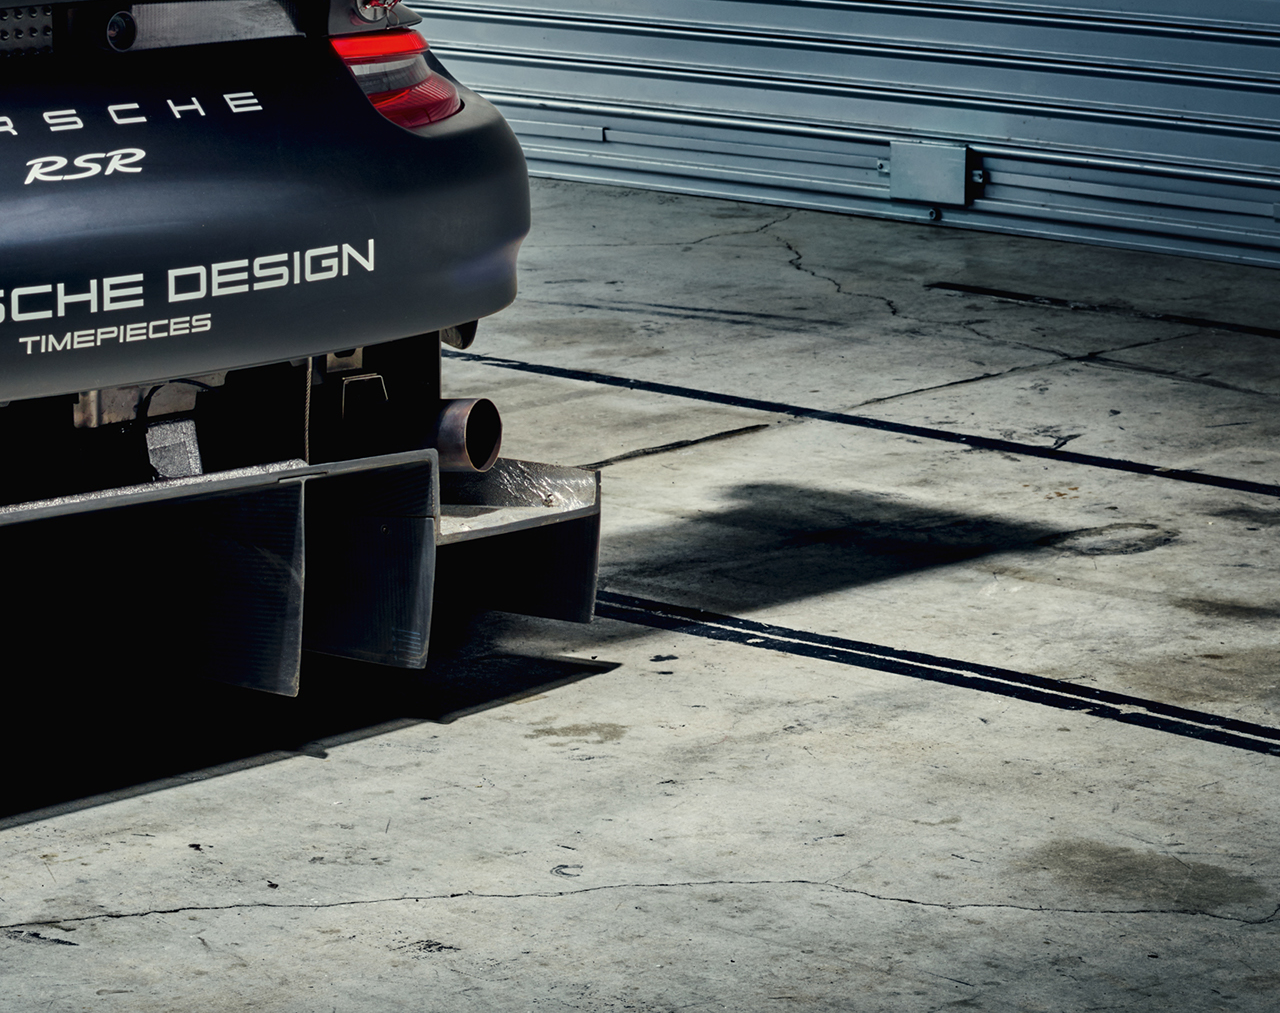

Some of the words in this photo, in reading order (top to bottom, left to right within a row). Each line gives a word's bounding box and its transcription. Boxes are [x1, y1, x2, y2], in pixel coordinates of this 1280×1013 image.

[23, 147, 146, 186] RSR
[167, 238, 376, 304] DESIGN
[18, 313, 212, 355] TIMEPIECES
